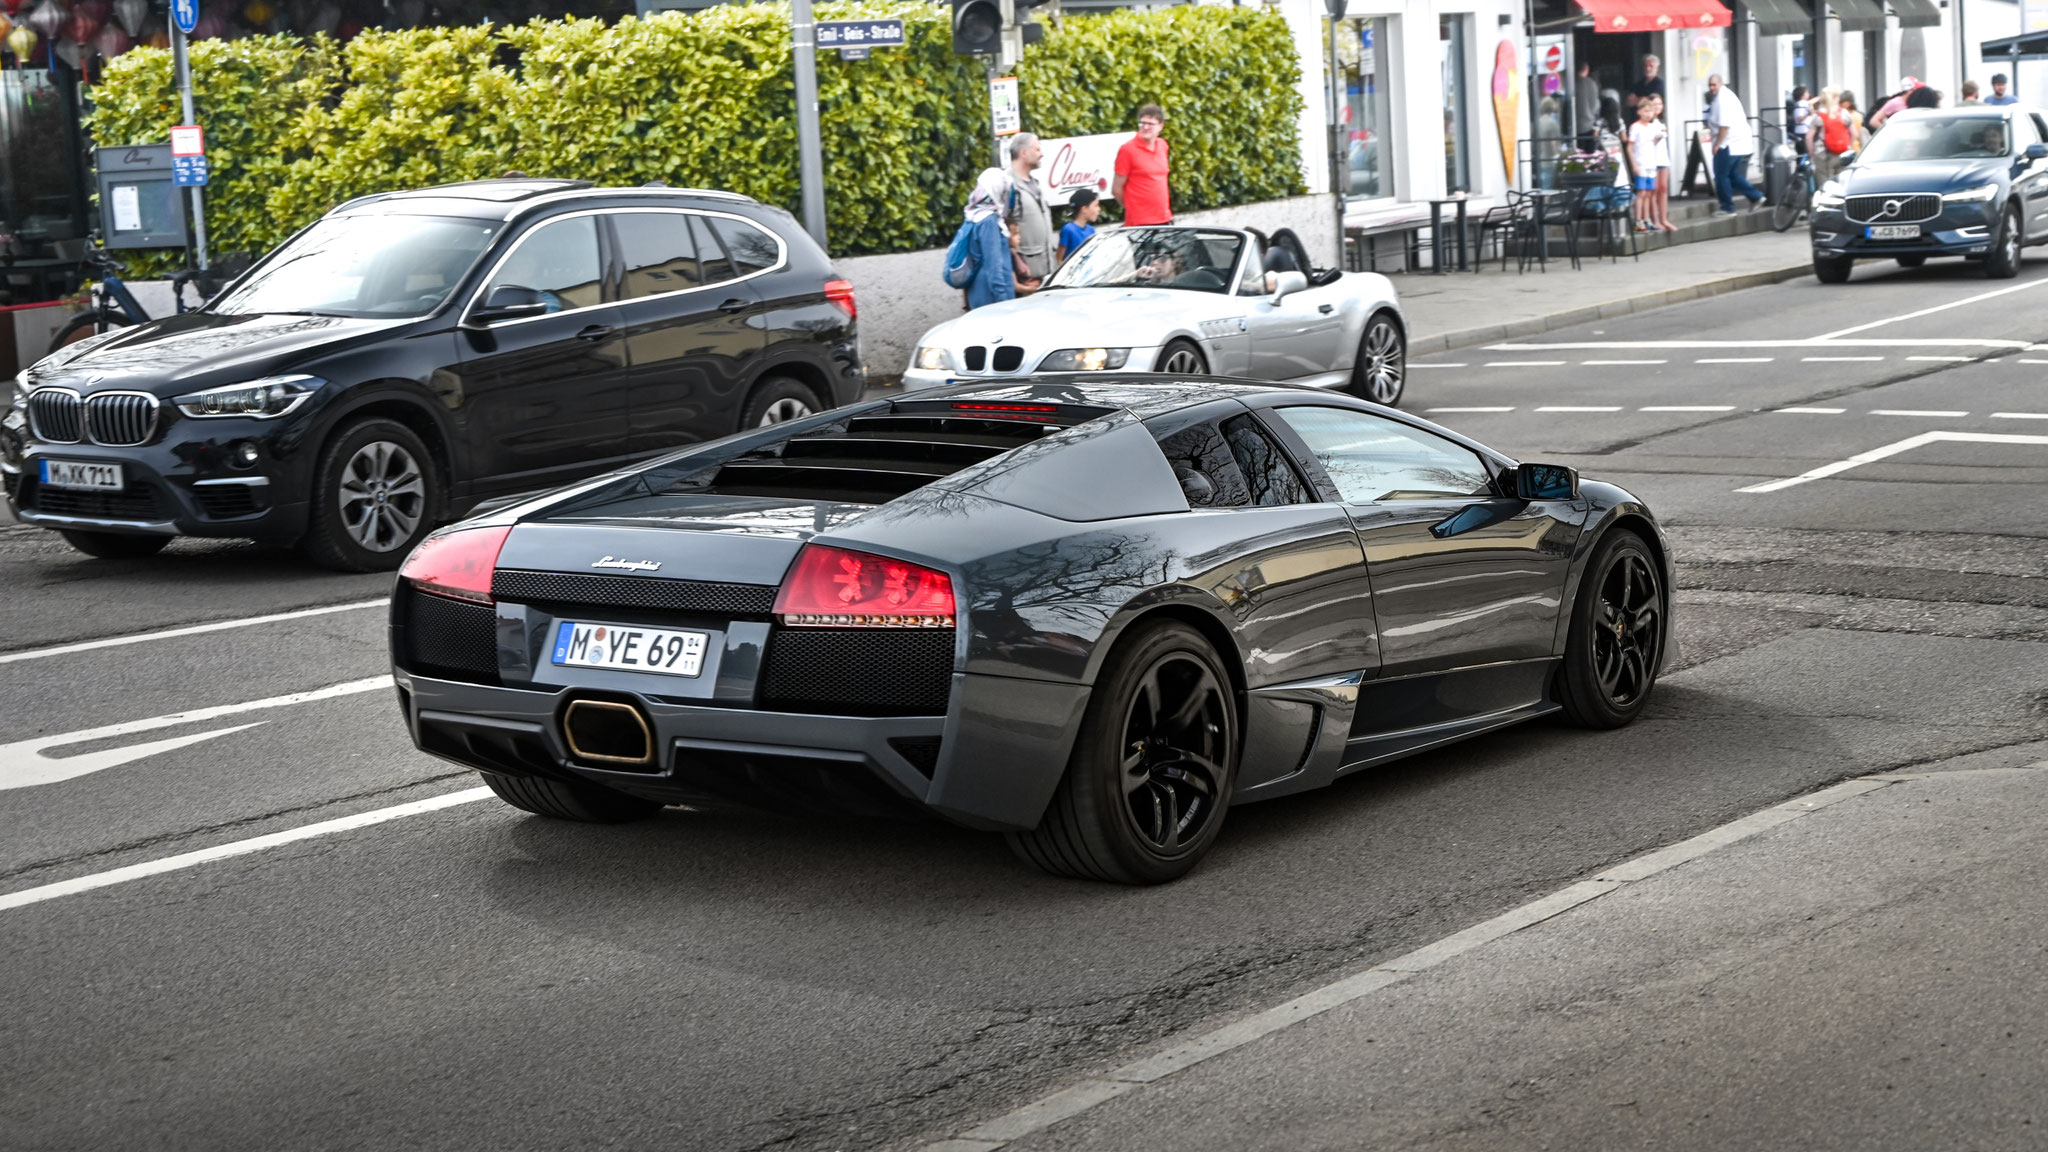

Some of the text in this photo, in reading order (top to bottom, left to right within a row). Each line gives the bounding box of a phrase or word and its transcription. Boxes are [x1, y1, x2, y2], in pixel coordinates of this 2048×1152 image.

[50, 463, 117, 486] M XK 711
[591, 555, 662, 572] Lamborghini
[557, 628, 684, 668] D M YE 69
